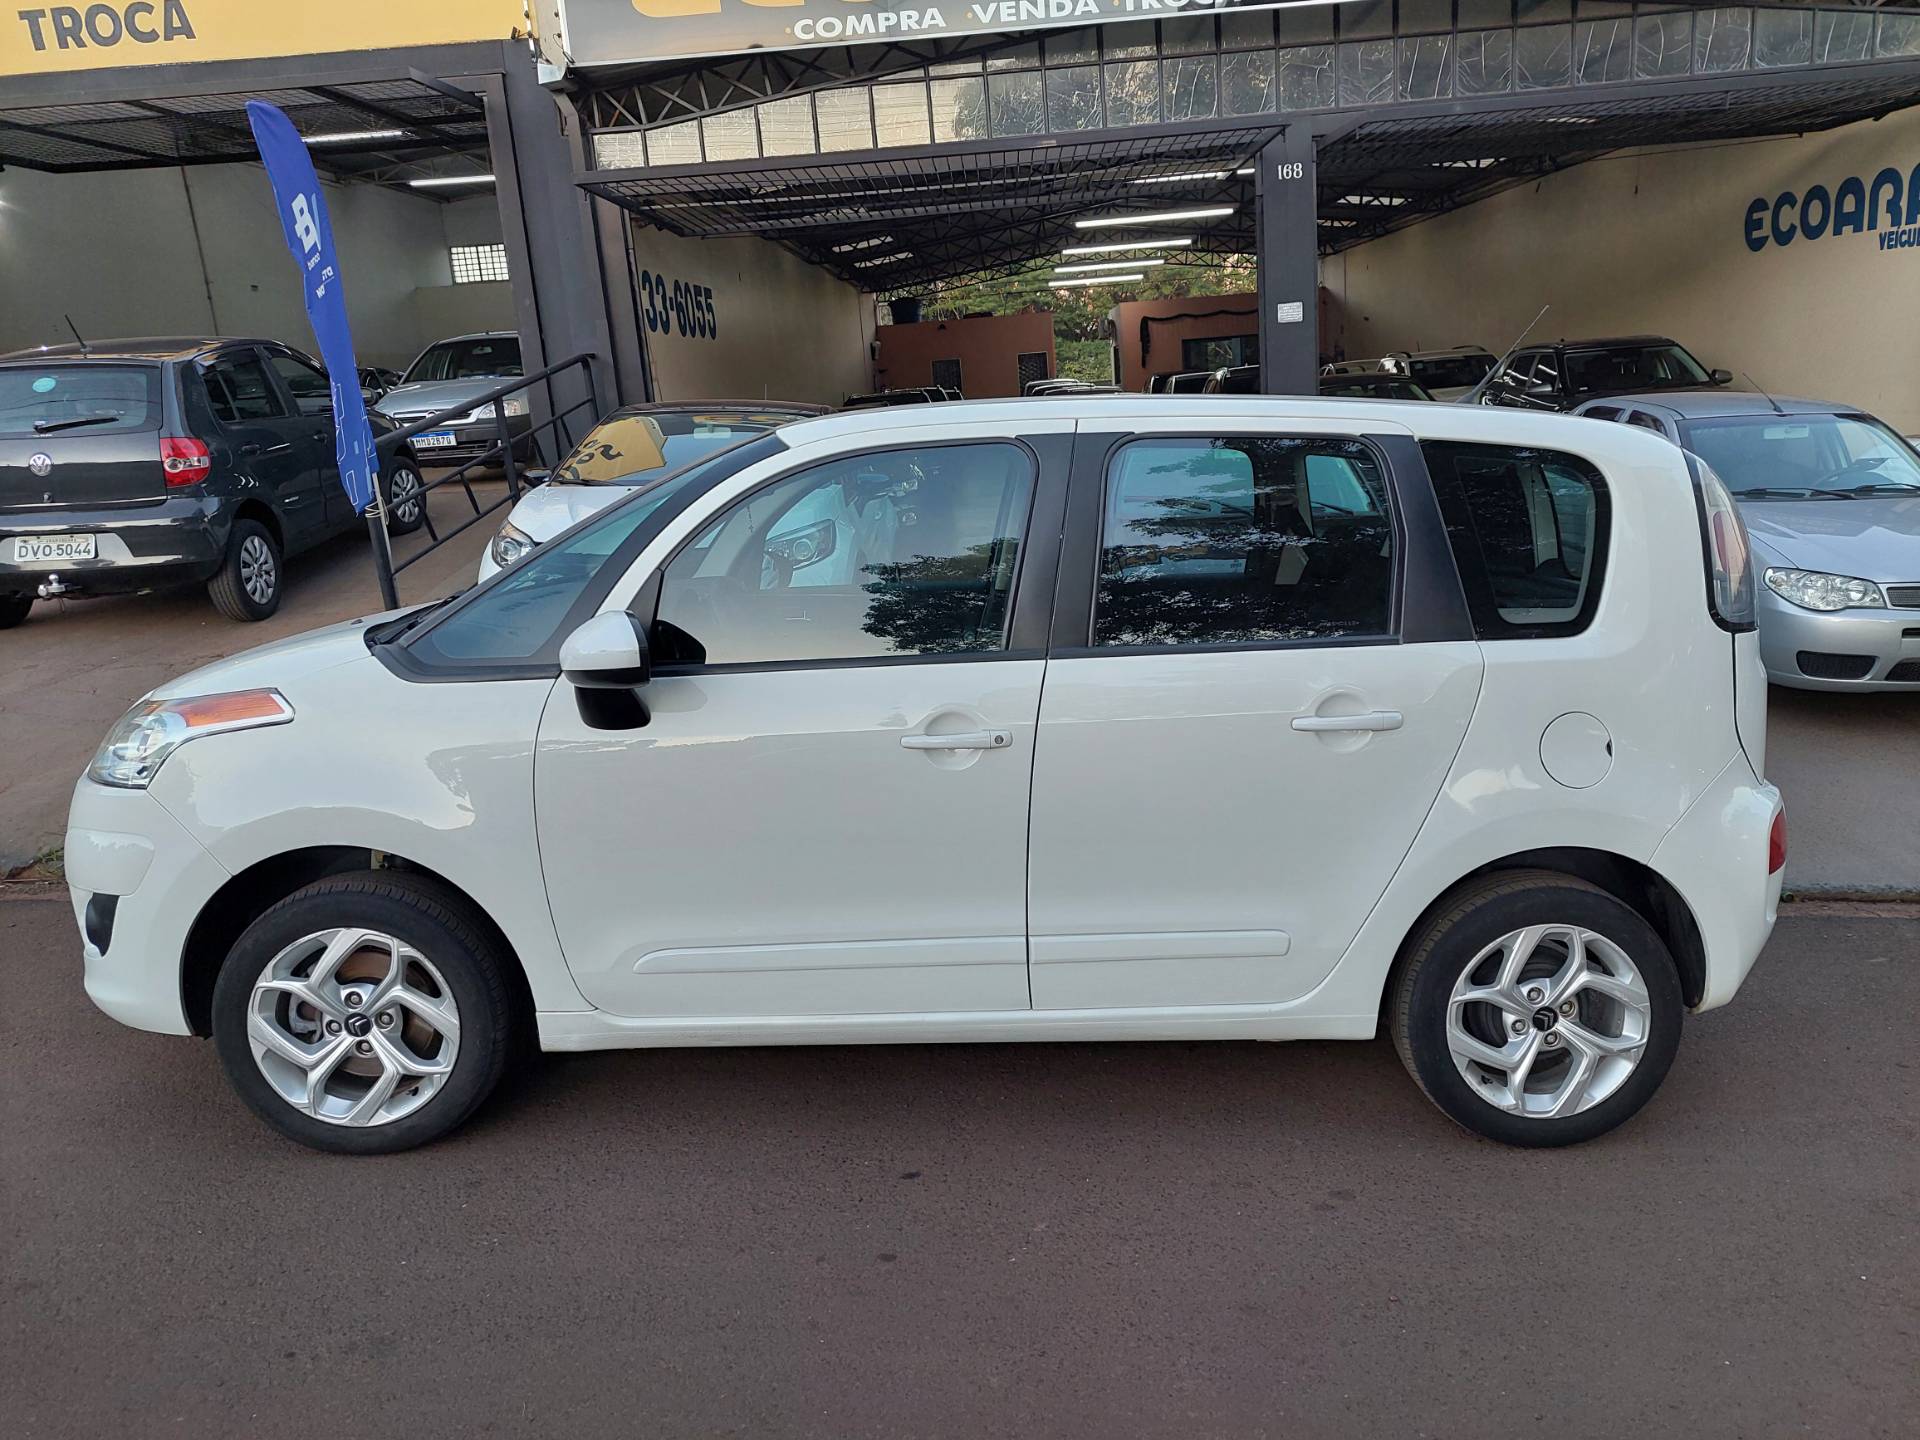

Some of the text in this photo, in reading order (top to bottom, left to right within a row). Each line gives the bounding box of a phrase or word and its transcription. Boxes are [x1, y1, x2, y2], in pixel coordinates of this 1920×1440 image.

[17, 0, 196, 51] TROCA
[793, 7, 947, 40] COMPRA
[972, 0, 1100, 25] VENDA
[1277, 162, 1303, 180] 168
[641, 269, 717, 340] 33-6055
